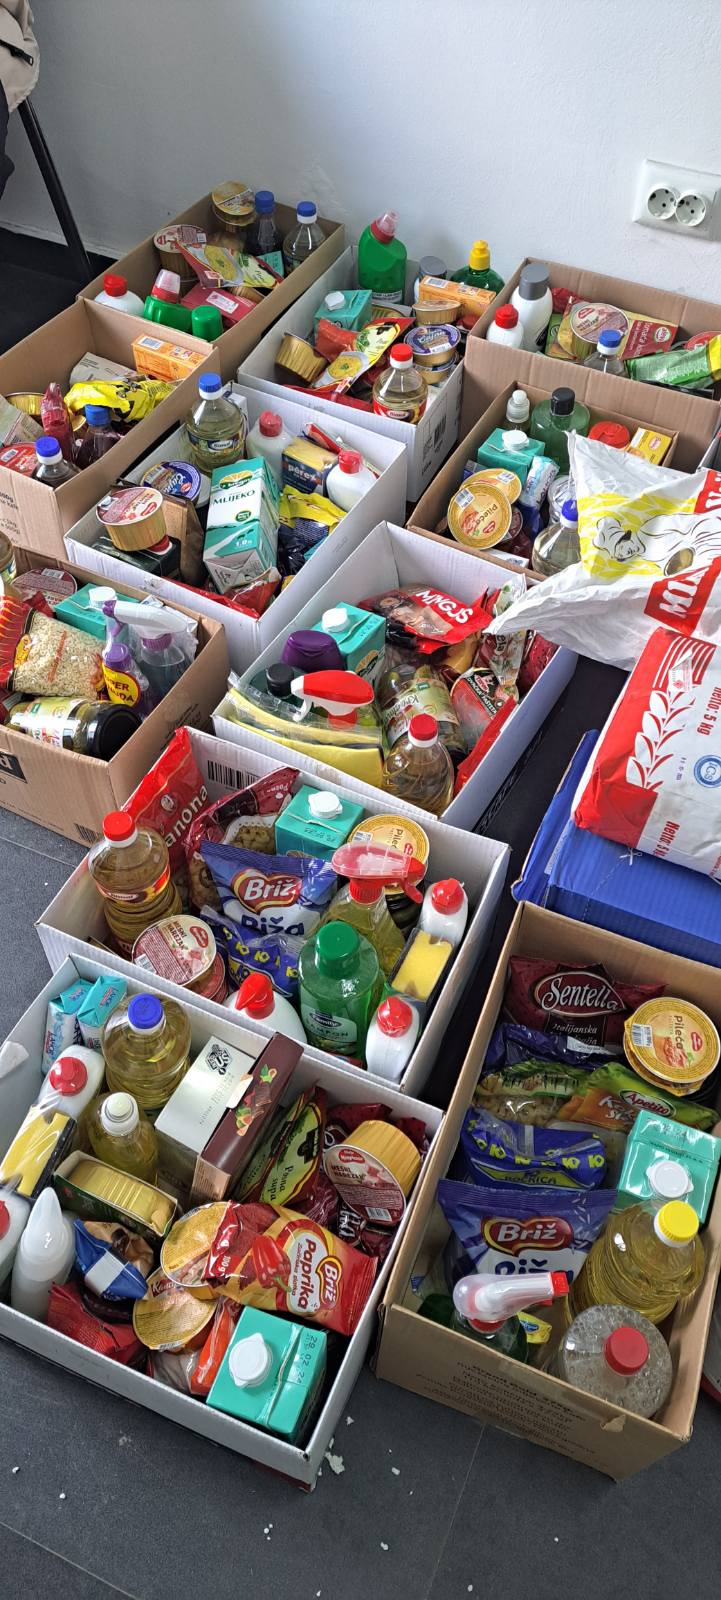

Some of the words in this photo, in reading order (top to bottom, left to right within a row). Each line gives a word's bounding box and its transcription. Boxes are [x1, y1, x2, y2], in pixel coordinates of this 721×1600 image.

[211, 489, 256, 505] MLIJEKO
[243, 879, 297, 901] Briž
[541, 976, 619, 1011] Sentella
[627, 1092, 670, 1115] Apetito
[498, 1222, 558, 1242] Briž
[297, 1238, 317, 1310] Paprika
[324, 1263, 338, 1302] Briž
